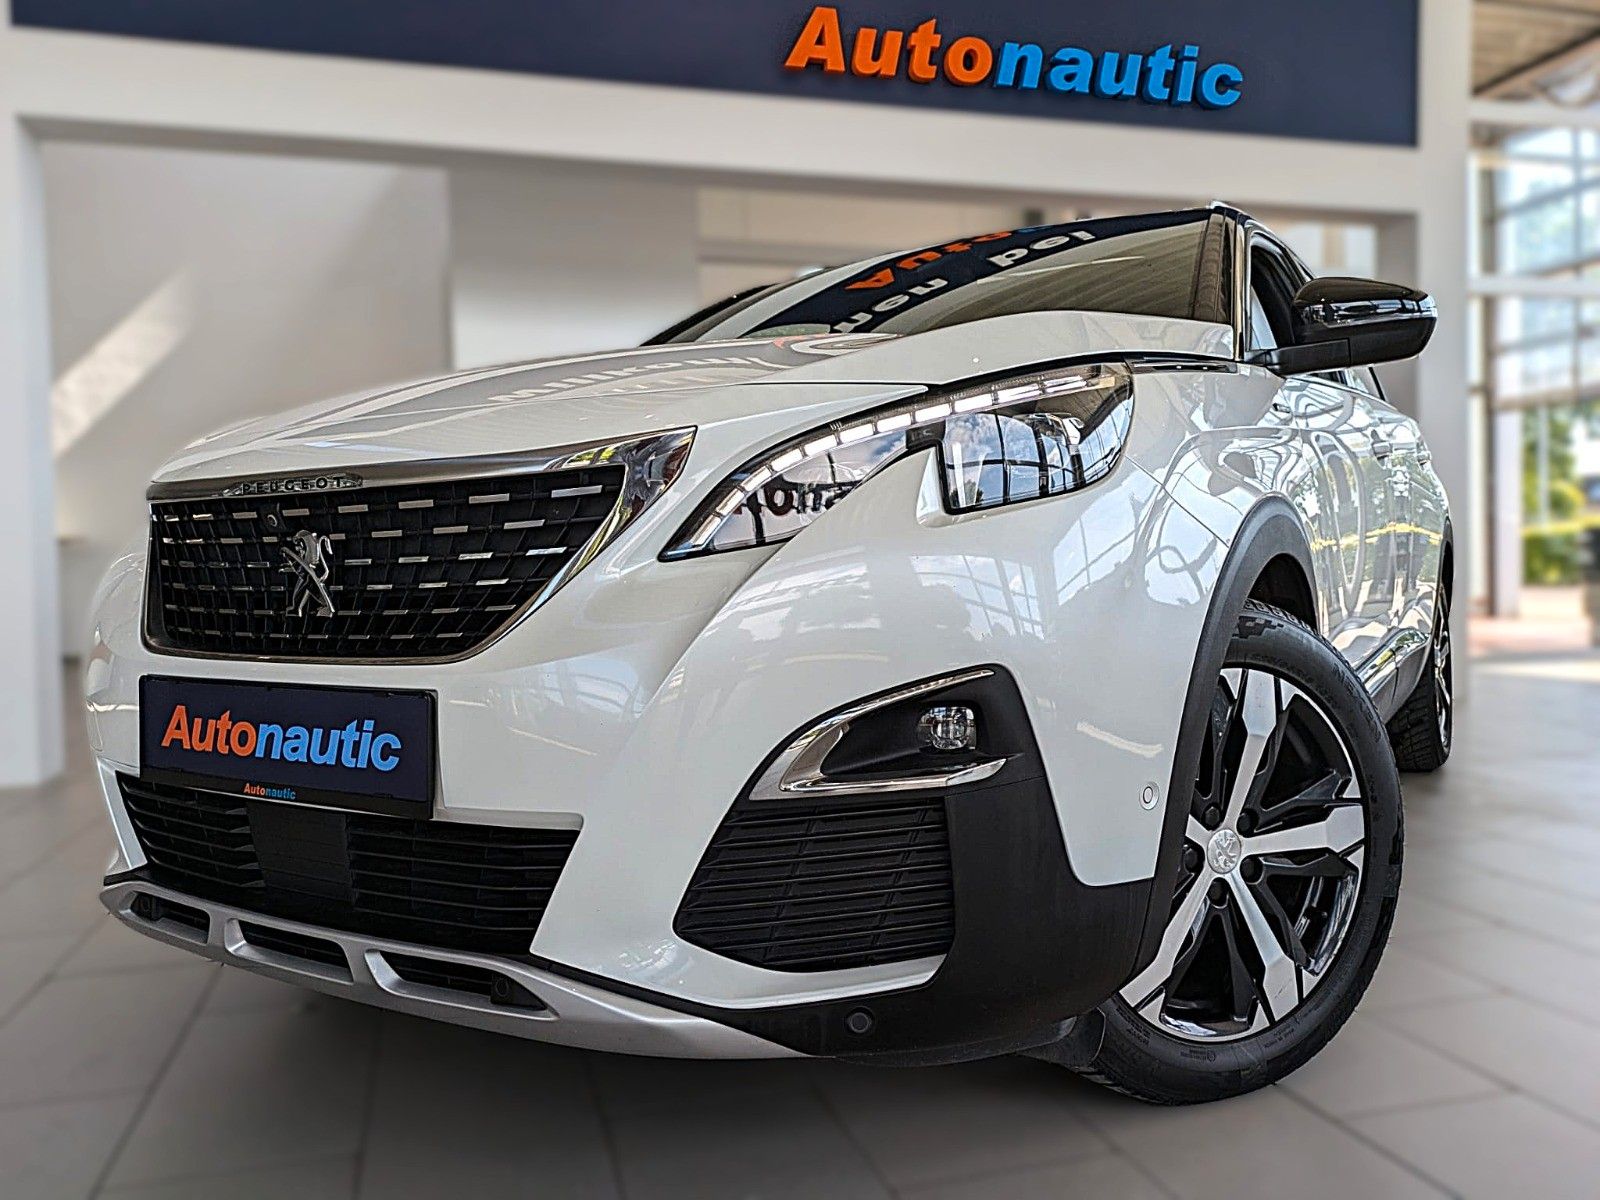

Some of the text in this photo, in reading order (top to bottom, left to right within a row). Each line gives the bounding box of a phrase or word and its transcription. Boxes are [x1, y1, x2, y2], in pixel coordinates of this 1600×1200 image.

[785, 6, 1244, 108] Autonautic
[242, 475, 345, 495] PEUGEOT
[161, 704, 401, 772] Autonautic
[243, 782, 296, 800] Autonautic
